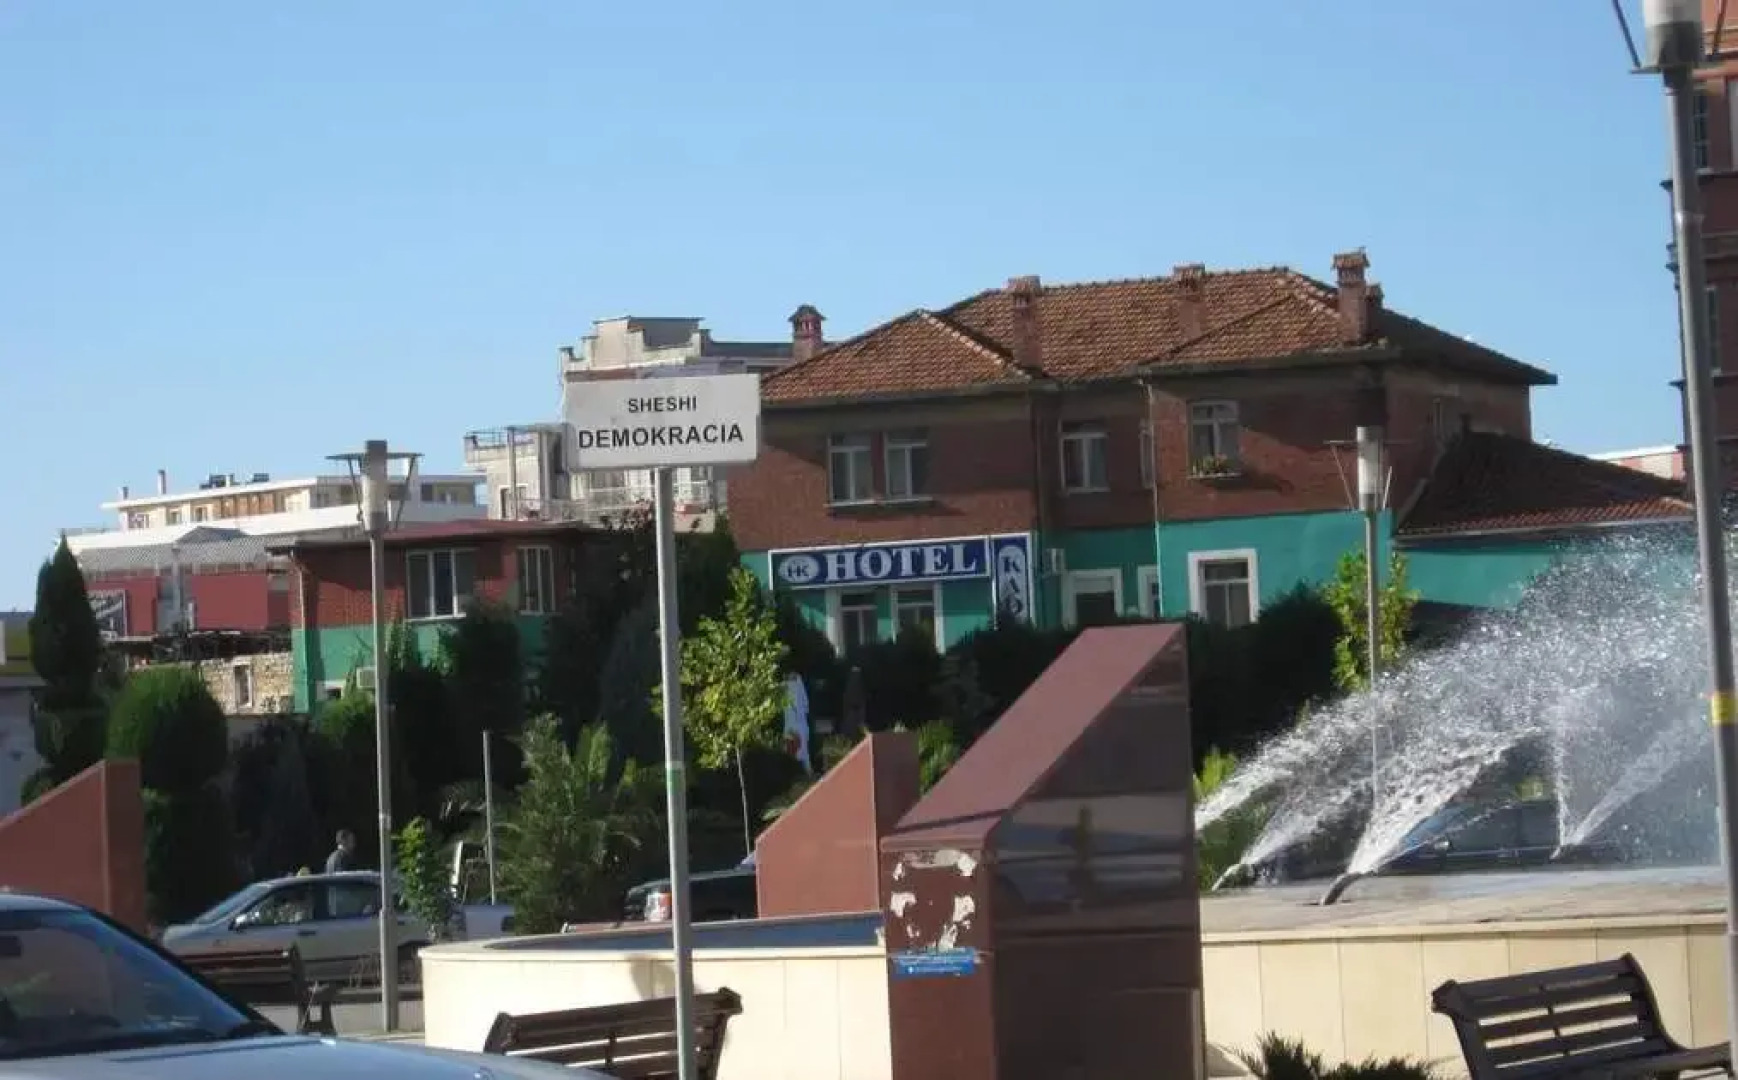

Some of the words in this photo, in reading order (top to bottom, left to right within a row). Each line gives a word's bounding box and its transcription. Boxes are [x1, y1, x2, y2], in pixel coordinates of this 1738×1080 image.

[628, 396, 697, 413] SHESHI
[578, 424, 744, 448] DEMOKRACIA
[824, 543, 977, 582] HOTEL
